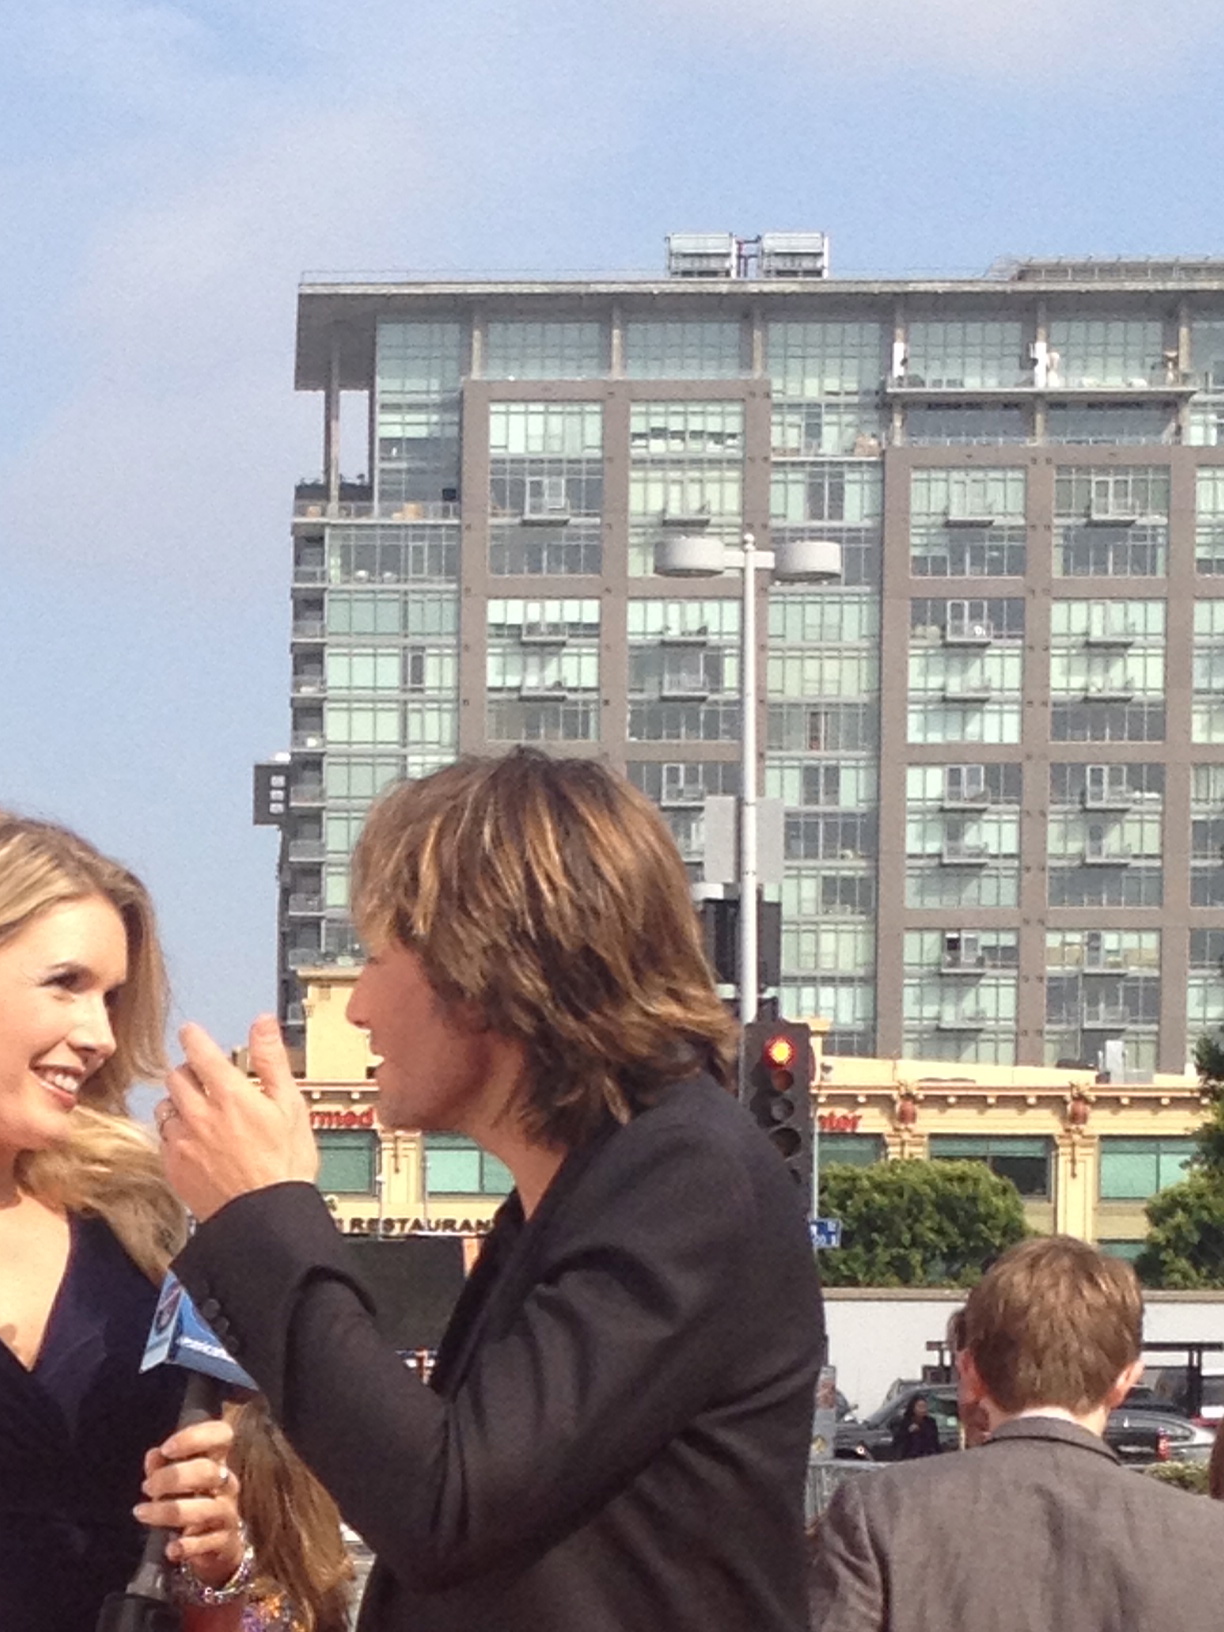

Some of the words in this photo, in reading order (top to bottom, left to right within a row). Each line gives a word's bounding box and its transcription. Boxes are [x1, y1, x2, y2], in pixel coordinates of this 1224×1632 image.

[310, 1108, 373, 1127] rmed
[818, 1111, 863, 1131] nter
[350, 1217, 494, 1232] RESTAURAN
